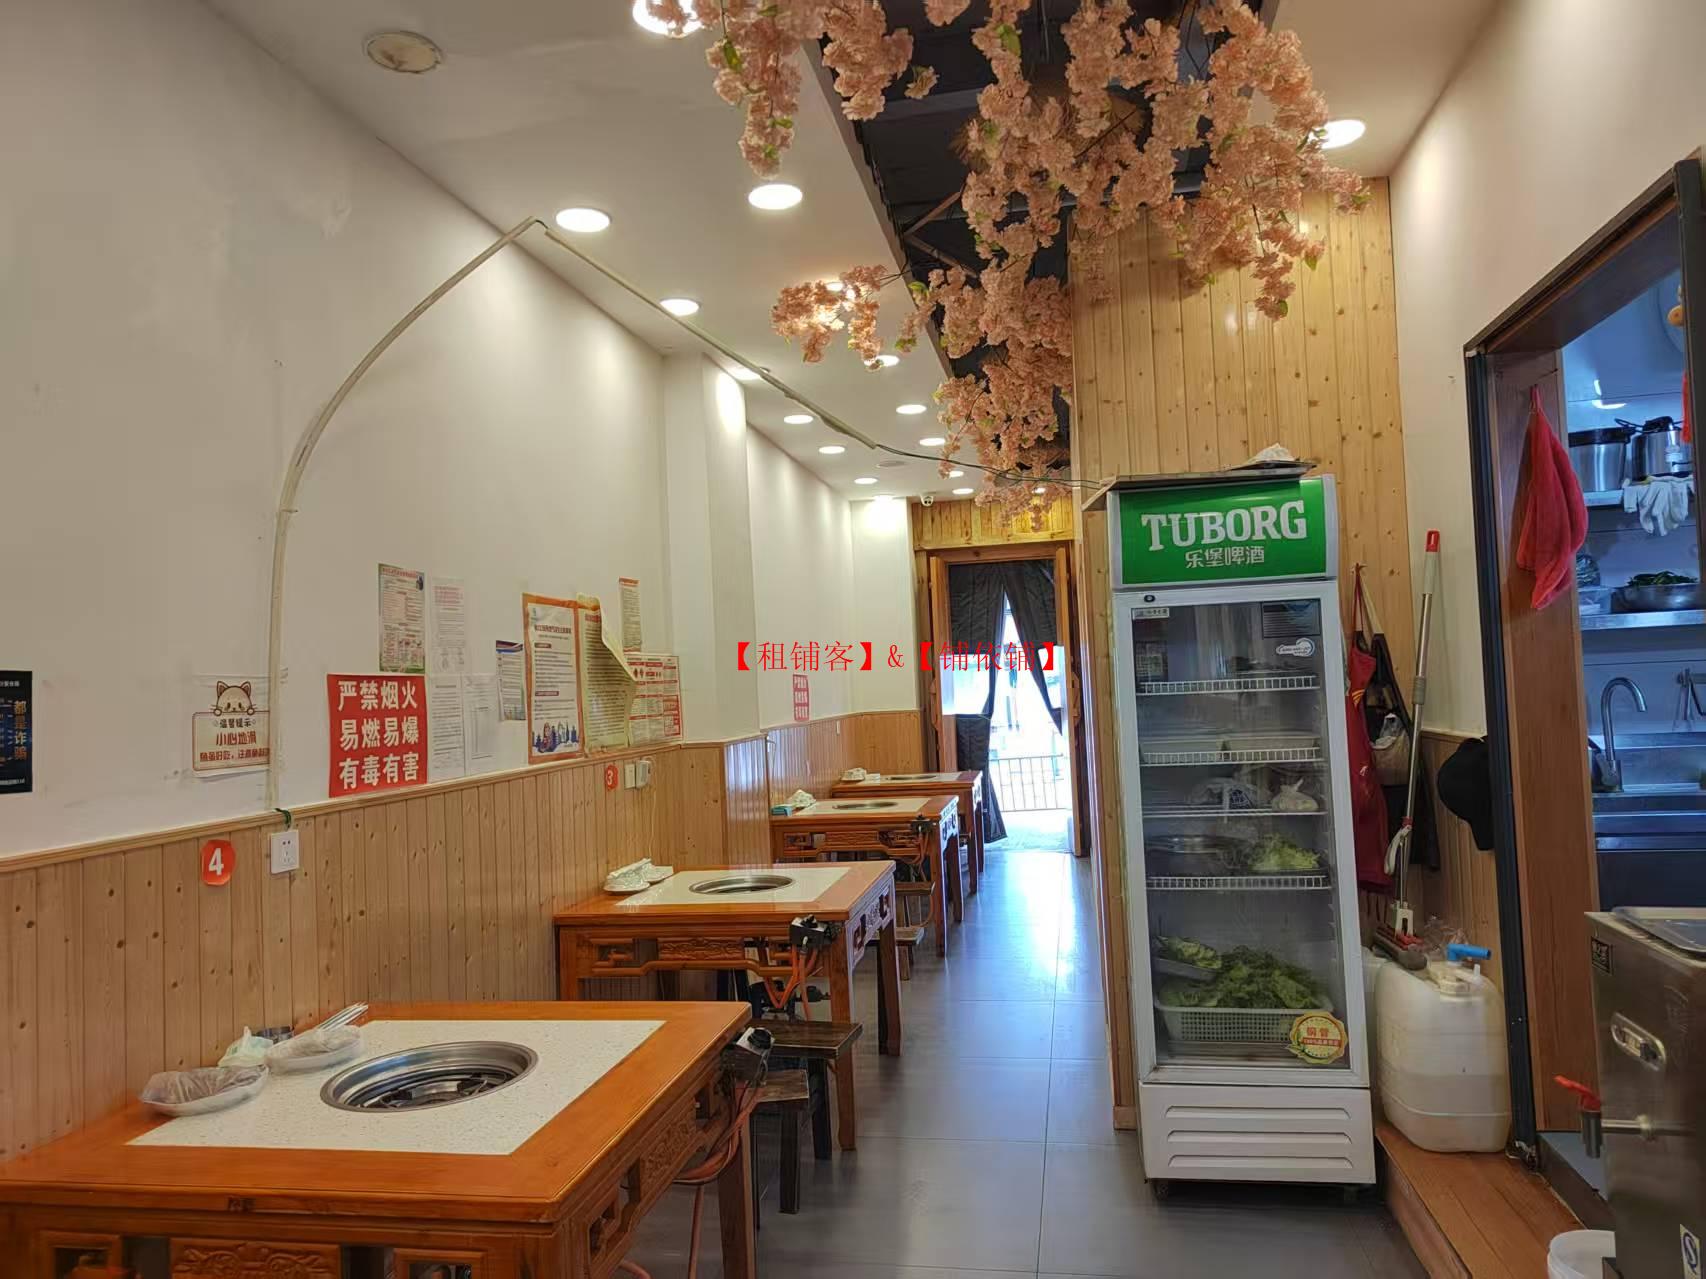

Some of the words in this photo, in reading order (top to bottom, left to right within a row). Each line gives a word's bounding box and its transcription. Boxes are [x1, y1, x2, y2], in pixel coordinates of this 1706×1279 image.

[1141, 500, 1307, 551] TUBORG
[1185, 546, 1265, 569] 乐堡啤酒
[338, 680, 418, 711] 严禁烟火
[216, 730, 257, 746] 小心地滑
[339, 716, 420, 751] 易燃易爆
[338, 752, 420, 790] 有毒有害
[607, 769, 614, 786] 3
[208, 847, 225, 876] 4
